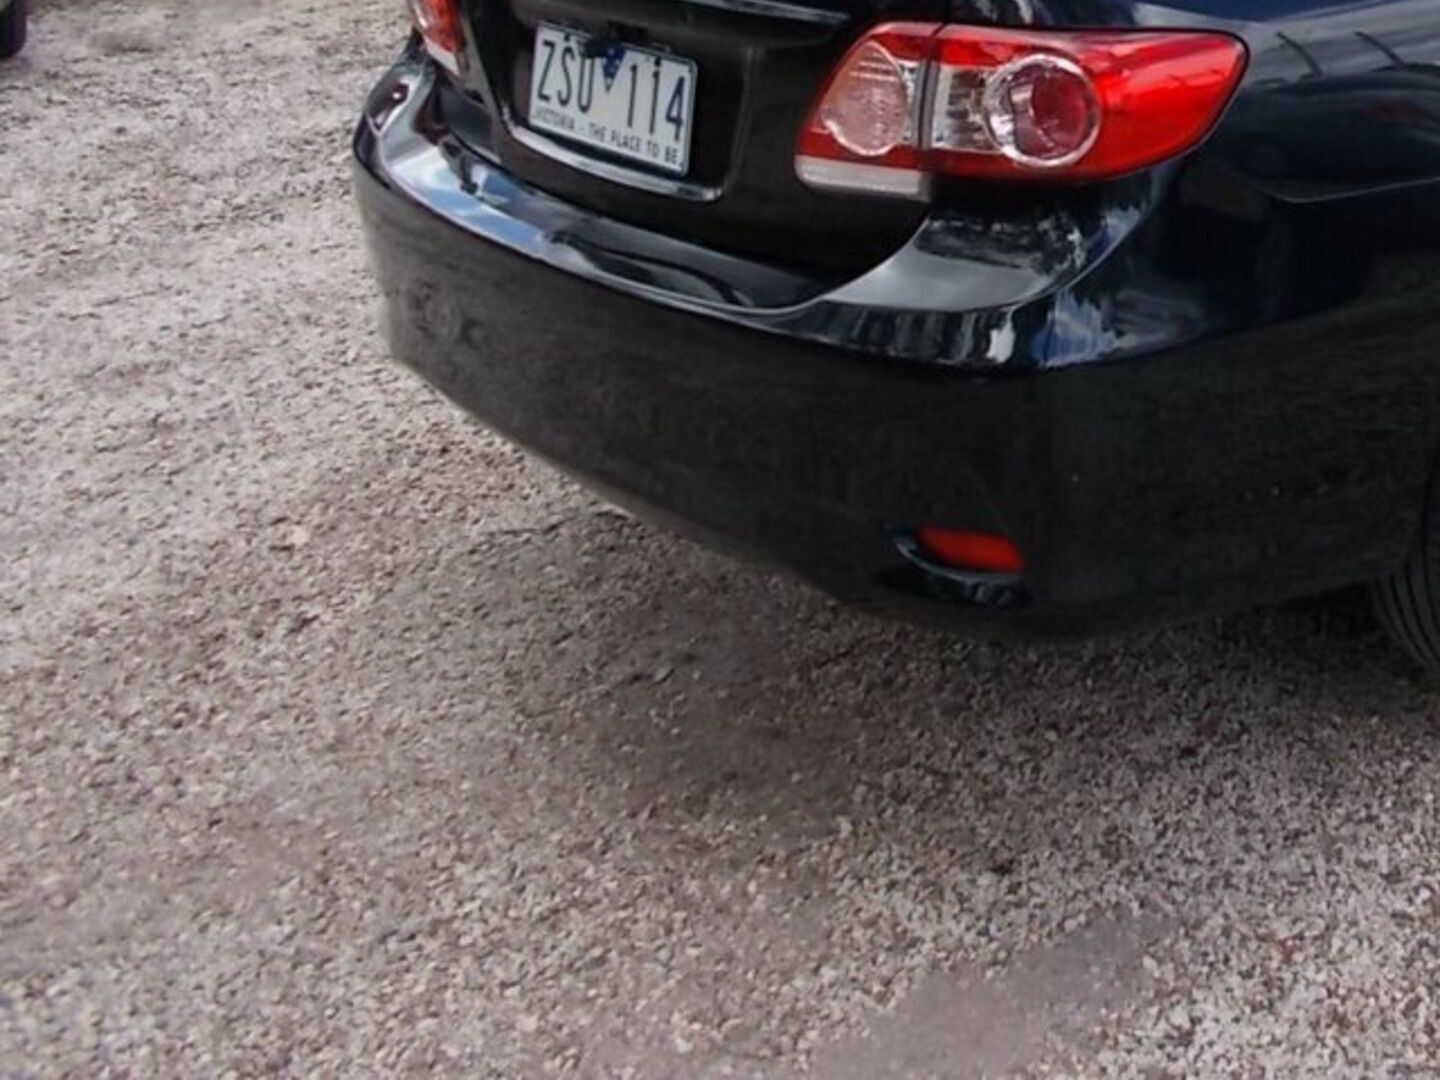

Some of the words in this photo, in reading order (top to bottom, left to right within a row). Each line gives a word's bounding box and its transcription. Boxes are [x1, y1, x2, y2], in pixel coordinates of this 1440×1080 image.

[629, 63, 685, 142] 114
[610, 127, 641, 153] PLACE
[647, 140, 660, 158] TO
[665, 146, 679, 165] BE
